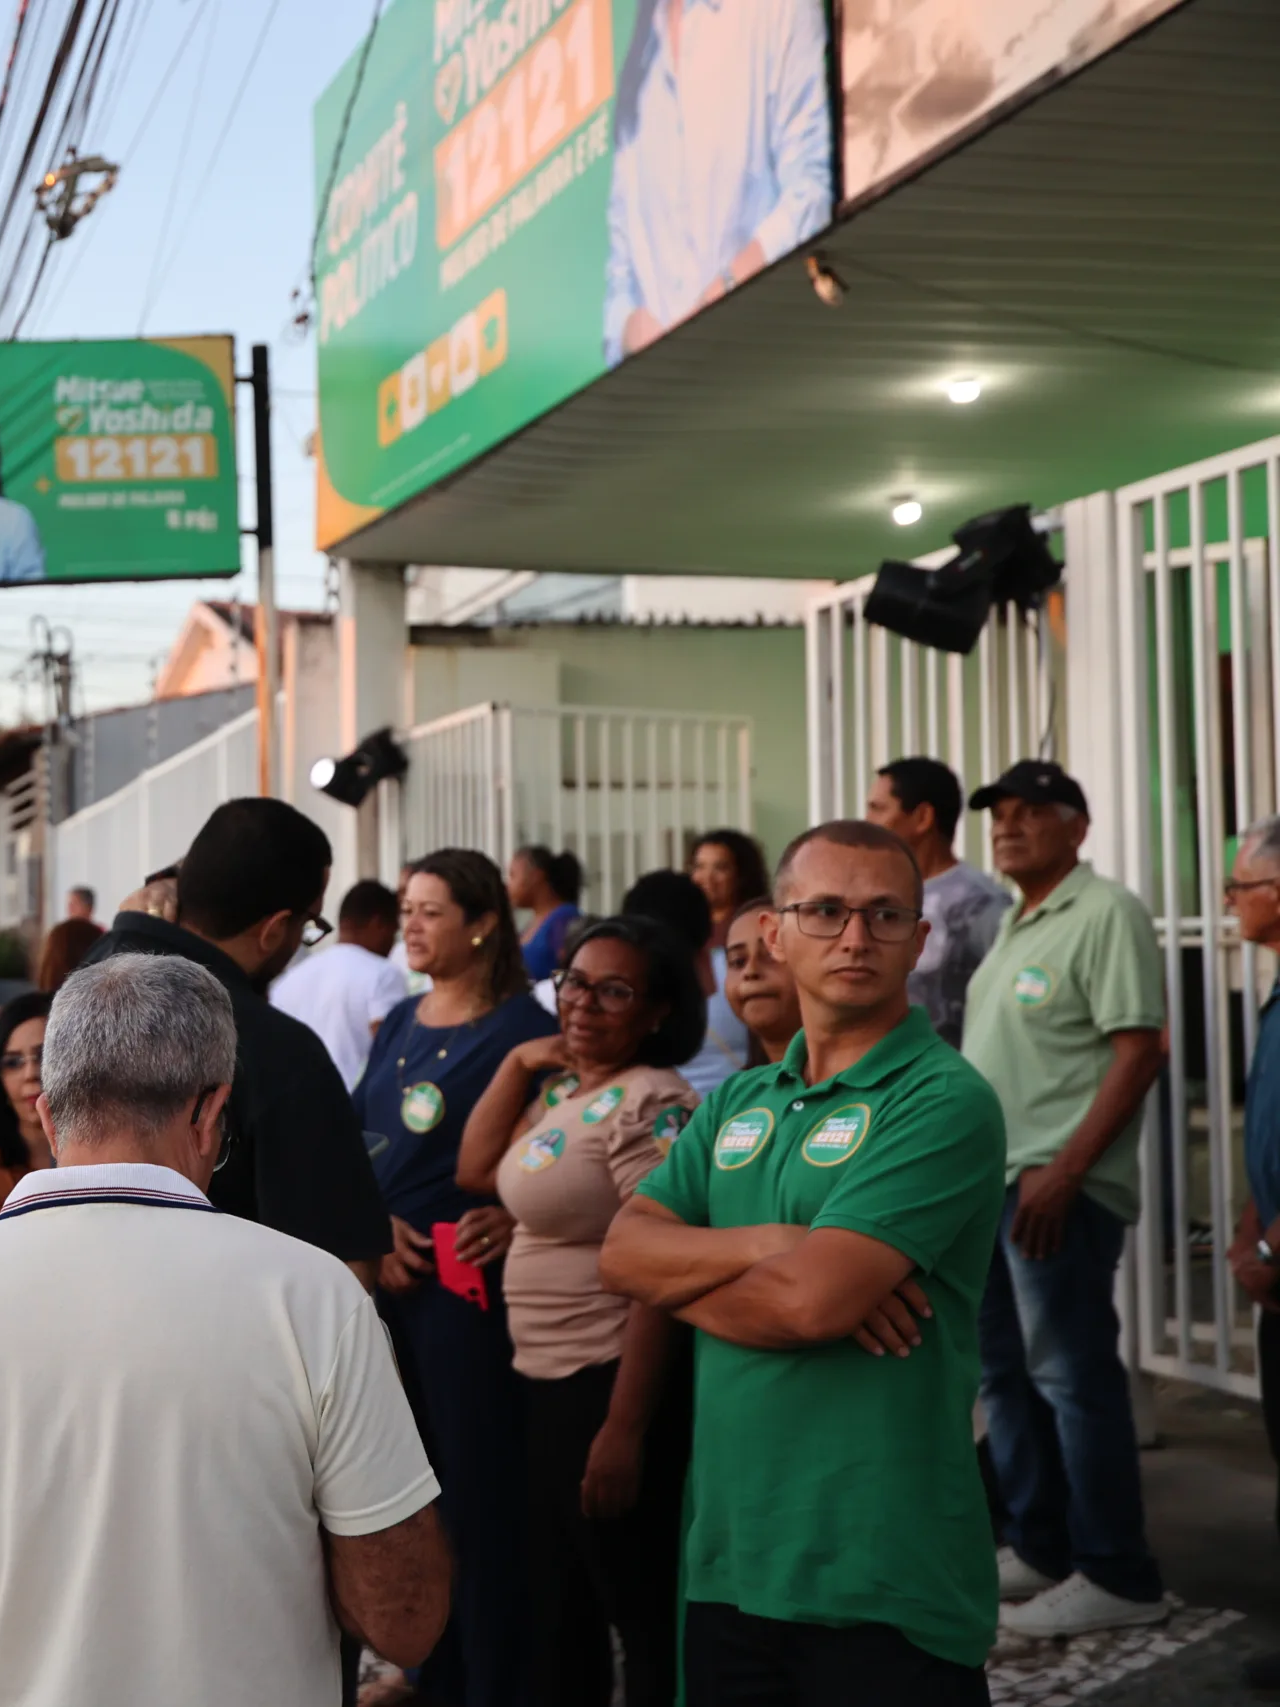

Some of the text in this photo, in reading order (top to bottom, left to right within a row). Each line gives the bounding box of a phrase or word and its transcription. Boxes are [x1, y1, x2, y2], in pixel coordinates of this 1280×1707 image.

[448, 3, 595, 226] 12121
[89, 400, 214, 433] Yoshida
[66, 436, 206, 479] 12121
